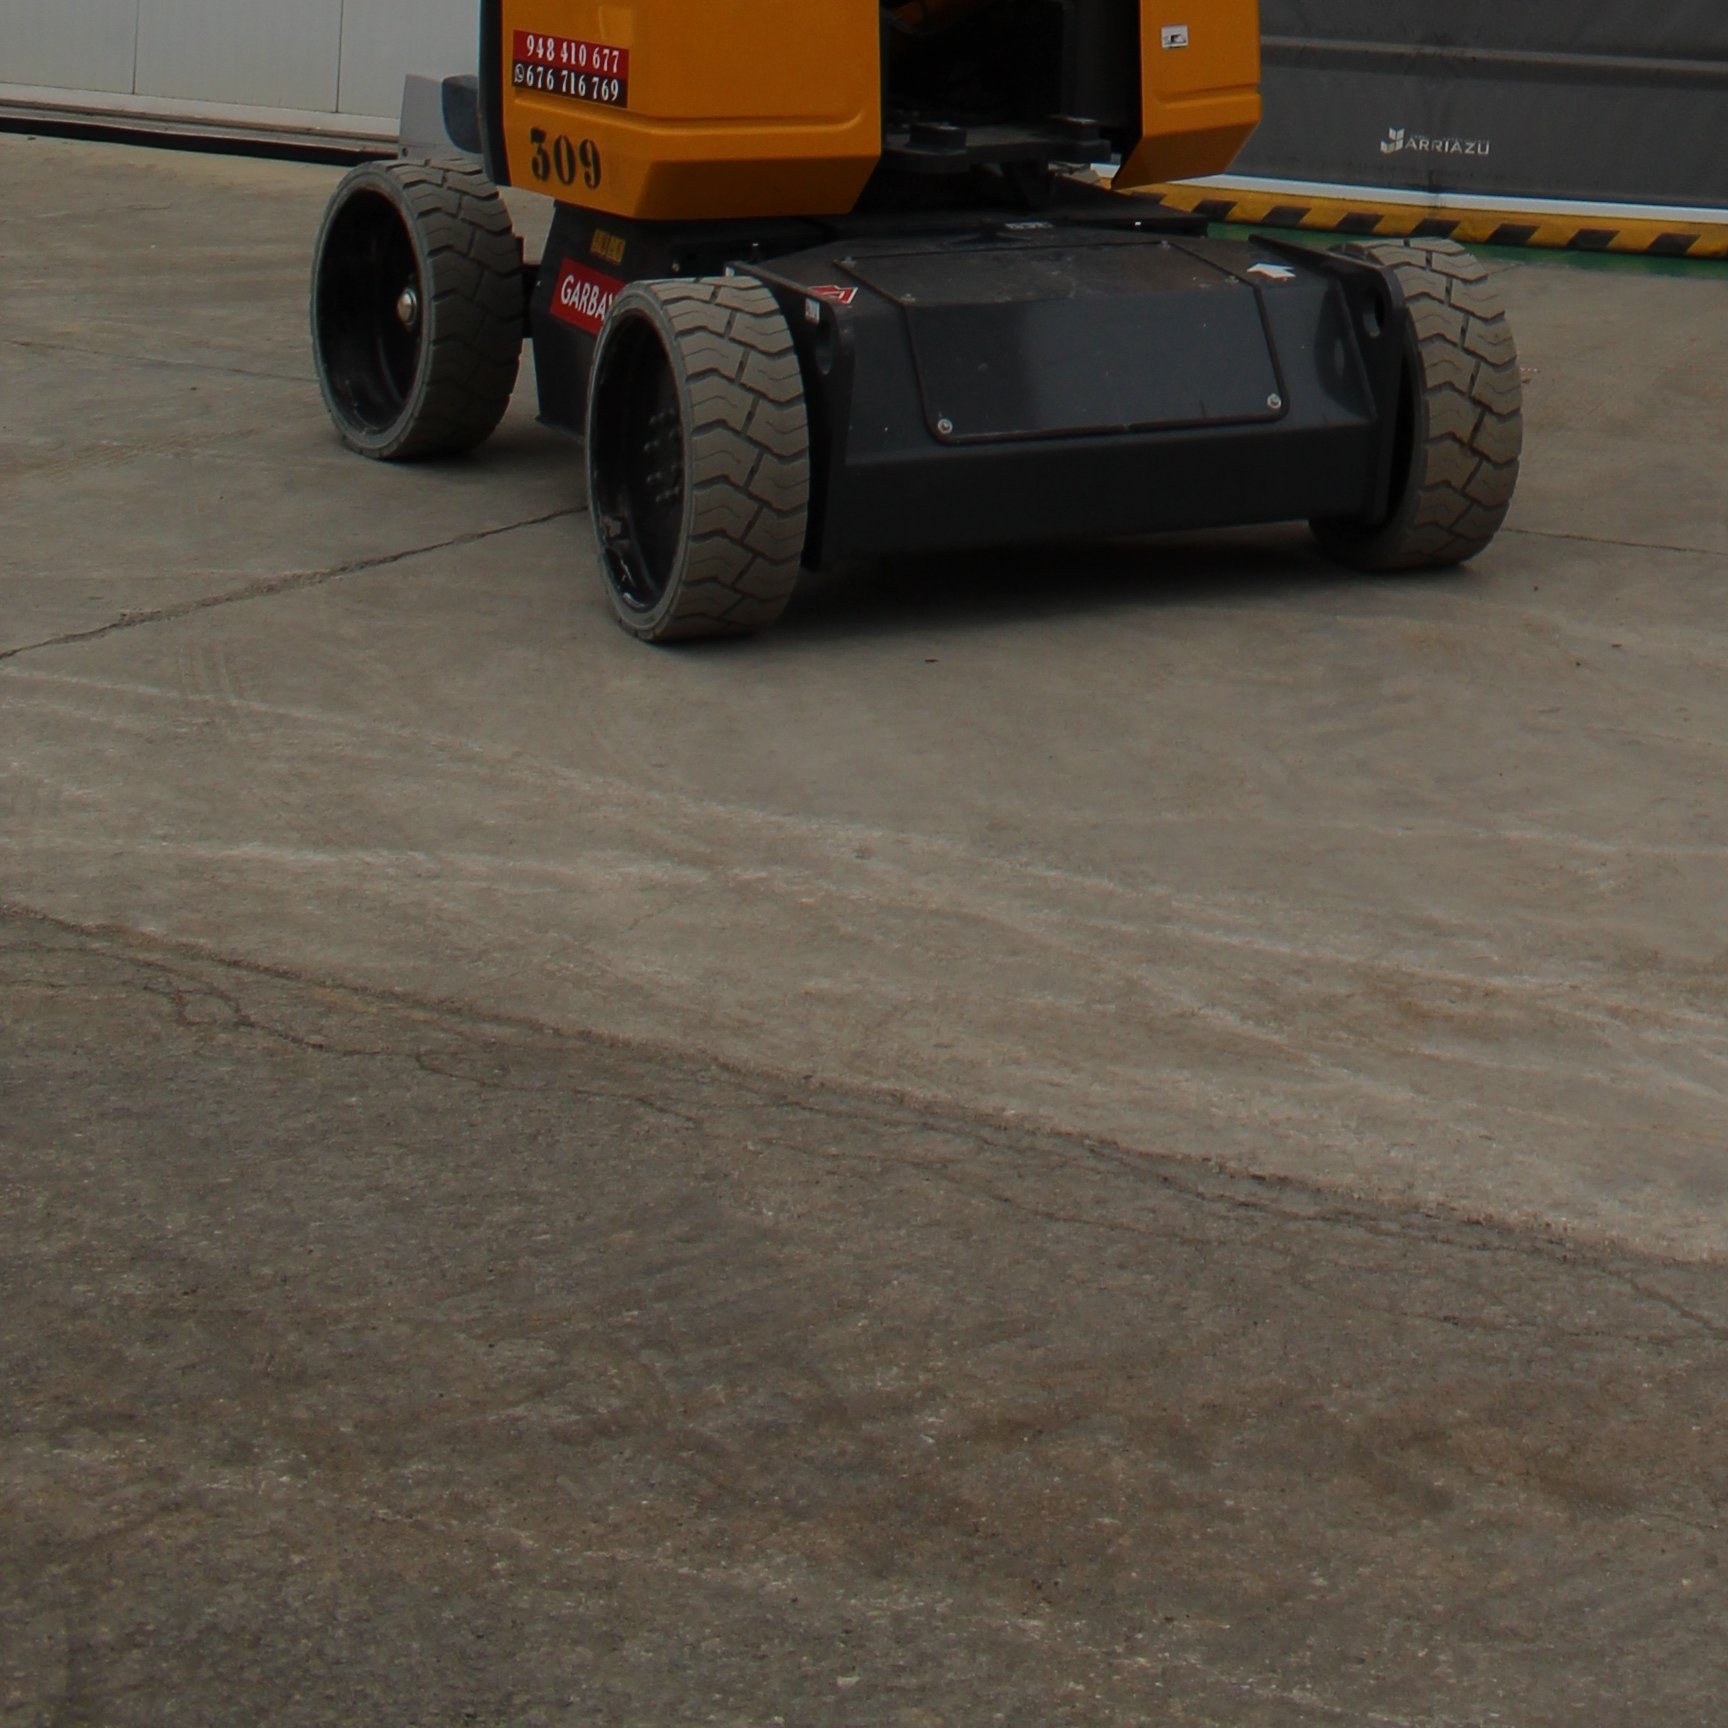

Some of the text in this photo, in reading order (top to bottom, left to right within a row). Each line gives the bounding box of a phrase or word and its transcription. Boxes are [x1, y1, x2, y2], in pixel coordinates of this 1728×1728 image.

[527, 34, 619, 73] 948 410 677
[526, 65, 619, 101] 676 716 769
[530, 126, 601, 190] 309
[1405, 137, 1490, 154] ARRIAZU
